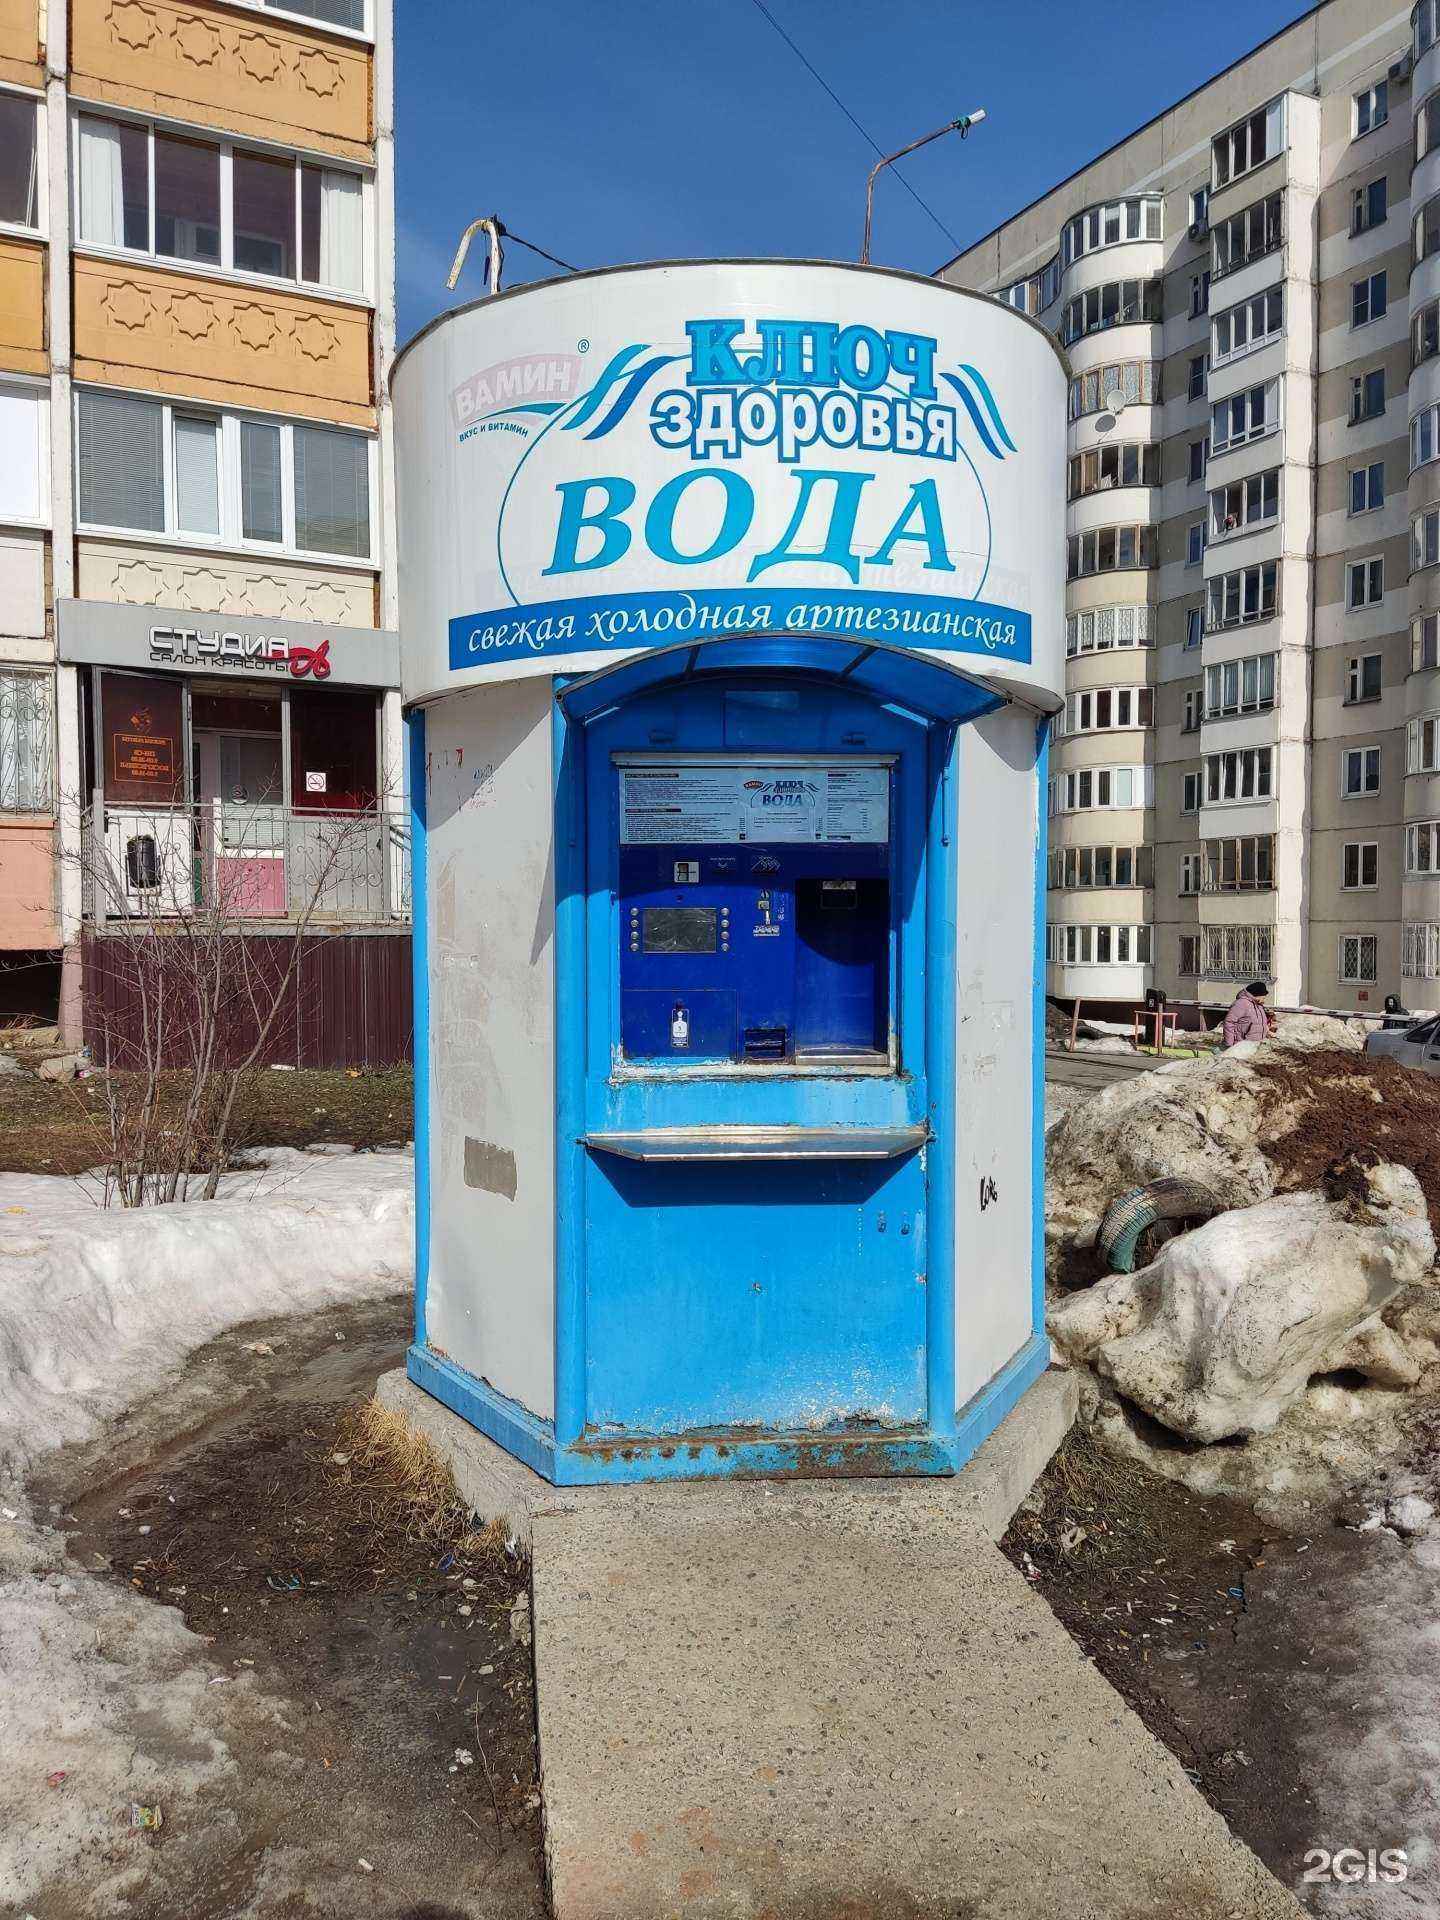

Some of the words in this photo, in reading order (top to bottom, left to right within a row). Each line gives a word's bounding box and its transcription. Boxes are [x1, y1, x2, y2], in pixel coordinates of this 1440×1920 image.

[685, 319, 938, 400] КЛЮЧ
[454, 361, 572, 419] ВАМИН
[459, 427, 478, 442] ВКУС
[480, 424, 486, 432] И
[488, 422, 528, 438] ВИТАМИН
[541, 467, 957, 584] ВОДА
[150, 626, 288, 658] СТУДИЯ
[468, 615, 576, 652] свежая
[585, 593, 773, 641] холодная
[785, 602, 1017, 649] артезианская
[150, 652, 206, 665] САЛОН
[211, 655, 289, 672] КРАСОТЫ
